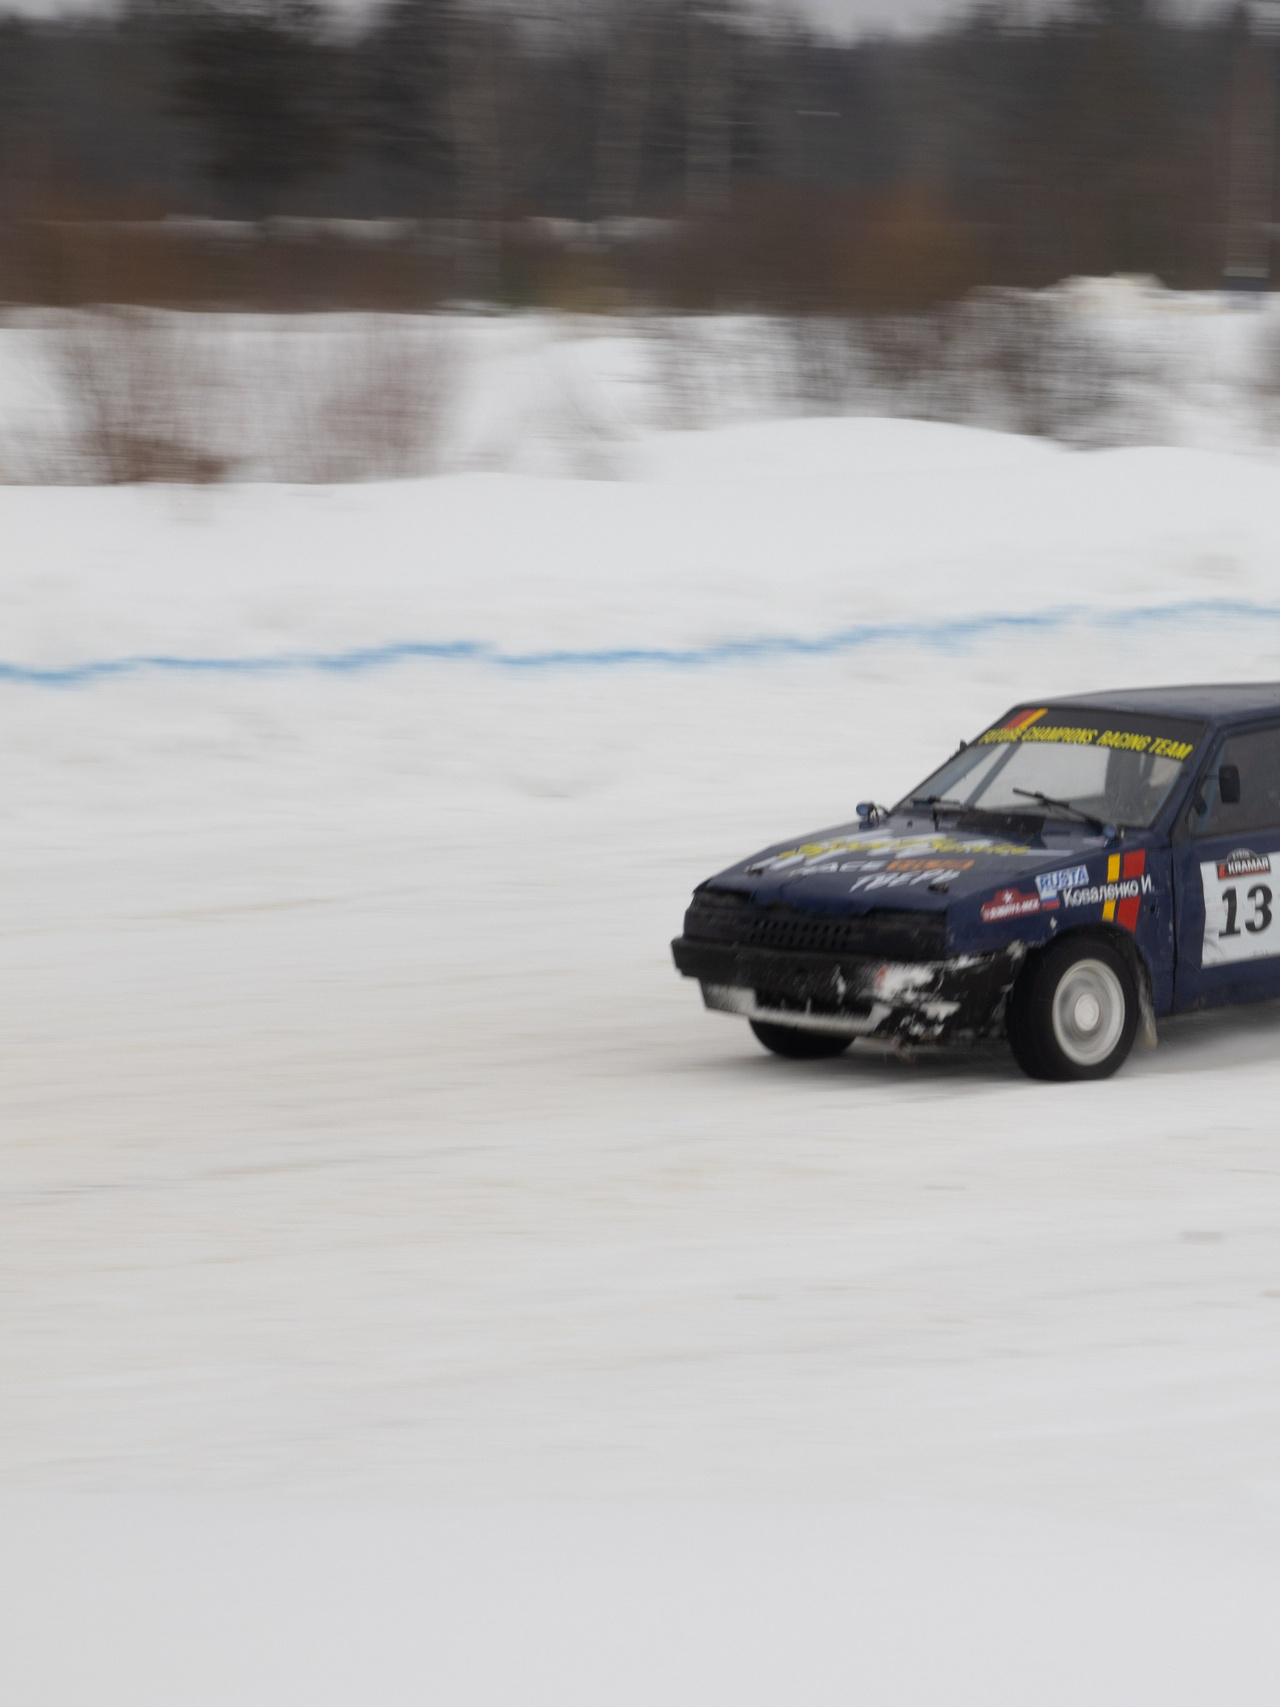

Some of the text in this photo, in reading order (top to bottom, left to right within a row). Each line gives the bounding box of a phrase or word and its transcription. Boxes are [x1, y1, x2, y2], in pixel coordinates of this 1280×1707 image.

[1021, 726, 1098, 744] CHAMPIONS
[1096, 729, 1151, 751] RACING
[1148, 737, 1194, 760] TEAM
[1039, 867, 1088, 892] RUSTA
[1227, 857, 1269, 875] KRAMAR
[1062, 879, 1139, 908] Коваленко
[1219, 883, 1272, 939] 13
